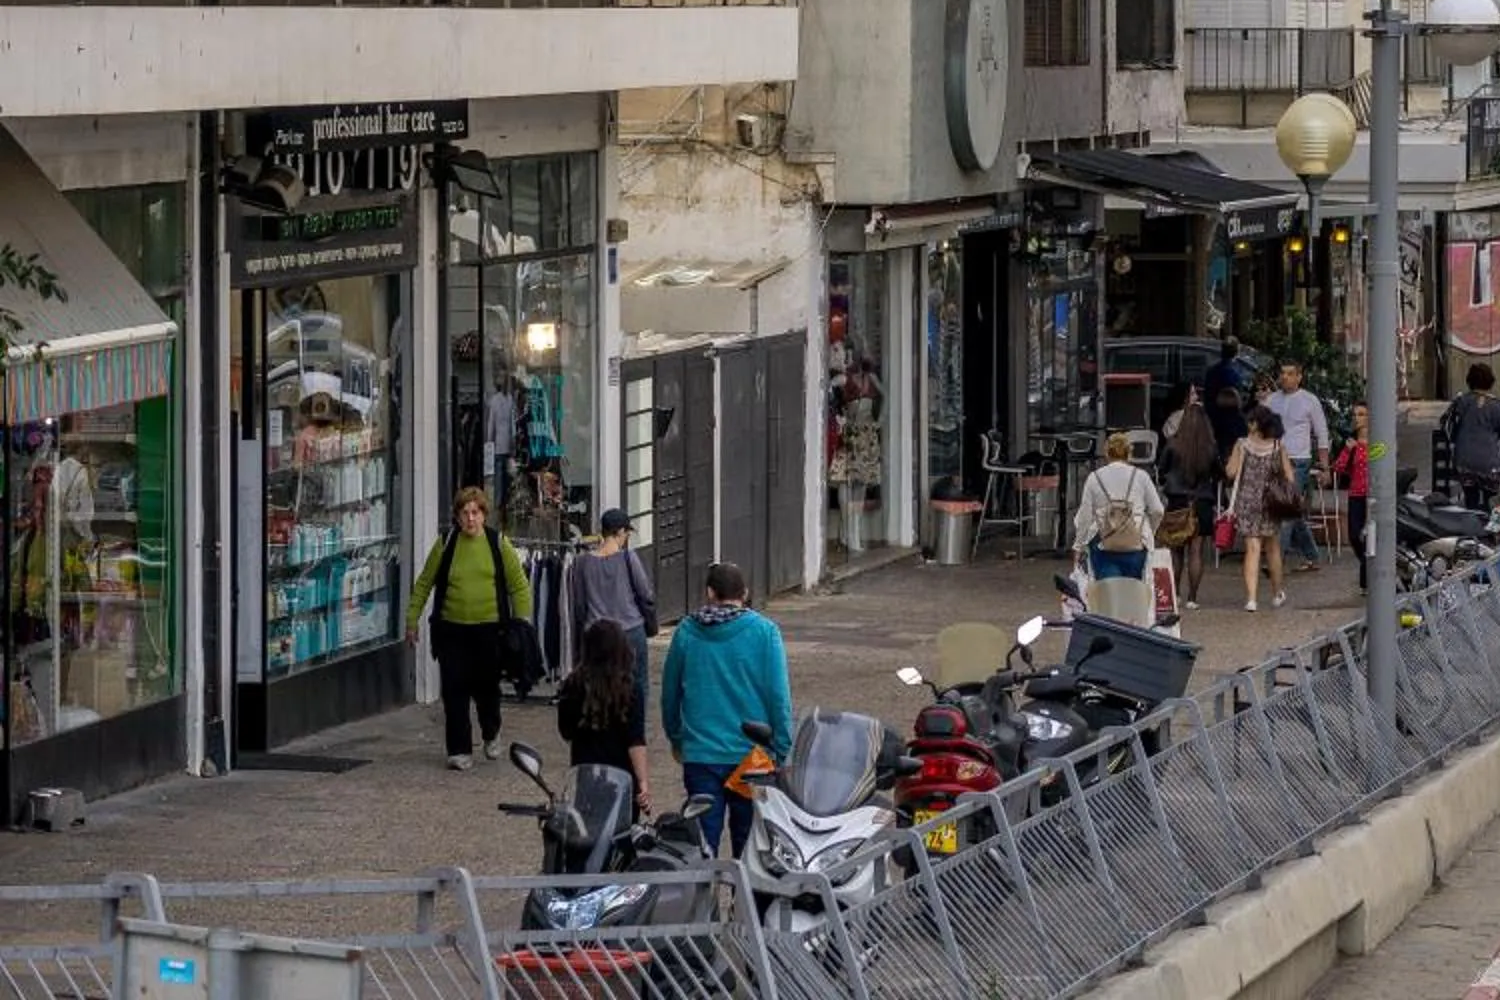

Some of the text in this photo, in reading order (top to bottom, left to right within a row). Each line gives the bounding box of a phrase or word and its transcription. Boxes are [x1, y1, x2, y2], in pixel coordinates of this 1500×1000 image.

[313, 104, 384, 150] professional
[386, 104, 409, 133] hair
[411, 111, 435, 131] care
